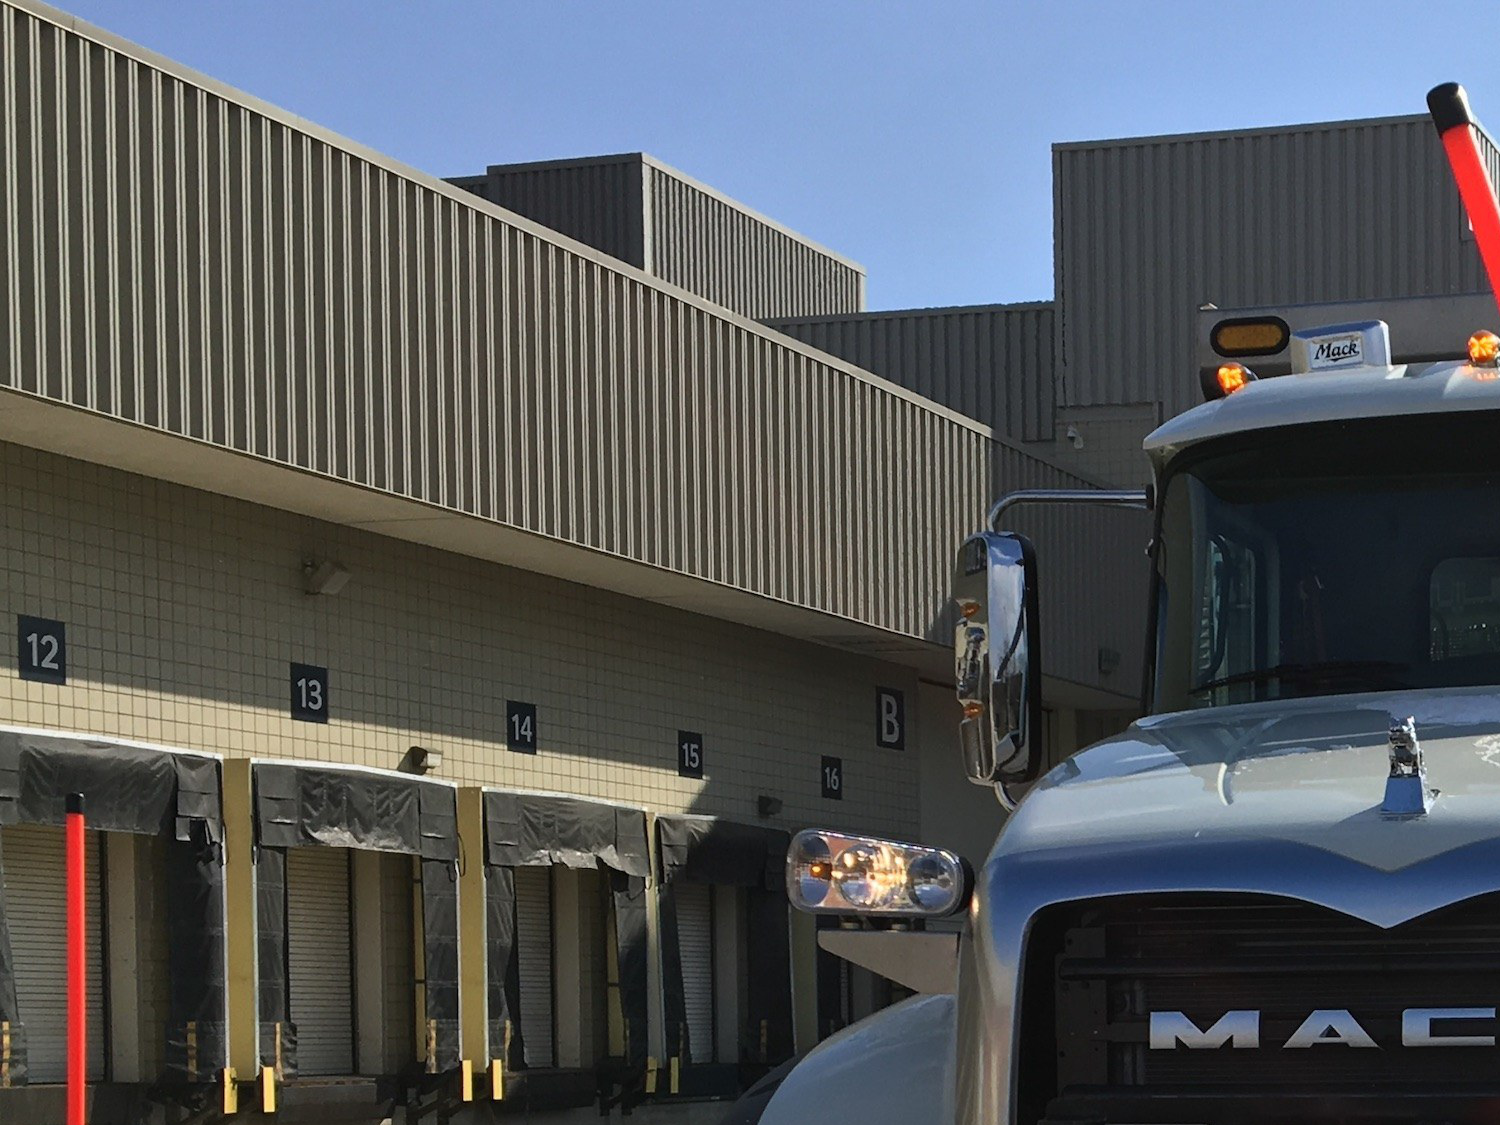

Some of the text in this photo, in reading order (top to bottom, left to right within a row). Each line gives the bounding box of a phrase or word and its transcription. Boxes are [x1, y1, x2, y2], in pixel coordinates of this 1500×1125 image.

[1314, 342, 1360, 361] Mack
[26, 632, 59, 670] 12
[297, 678, 323, 710] 13
[511, 714, 533, 743] 14
[880, 694, 900, 744] B
[681, 743, 700, 768] 15
[824, 766, 839, 791] 16
